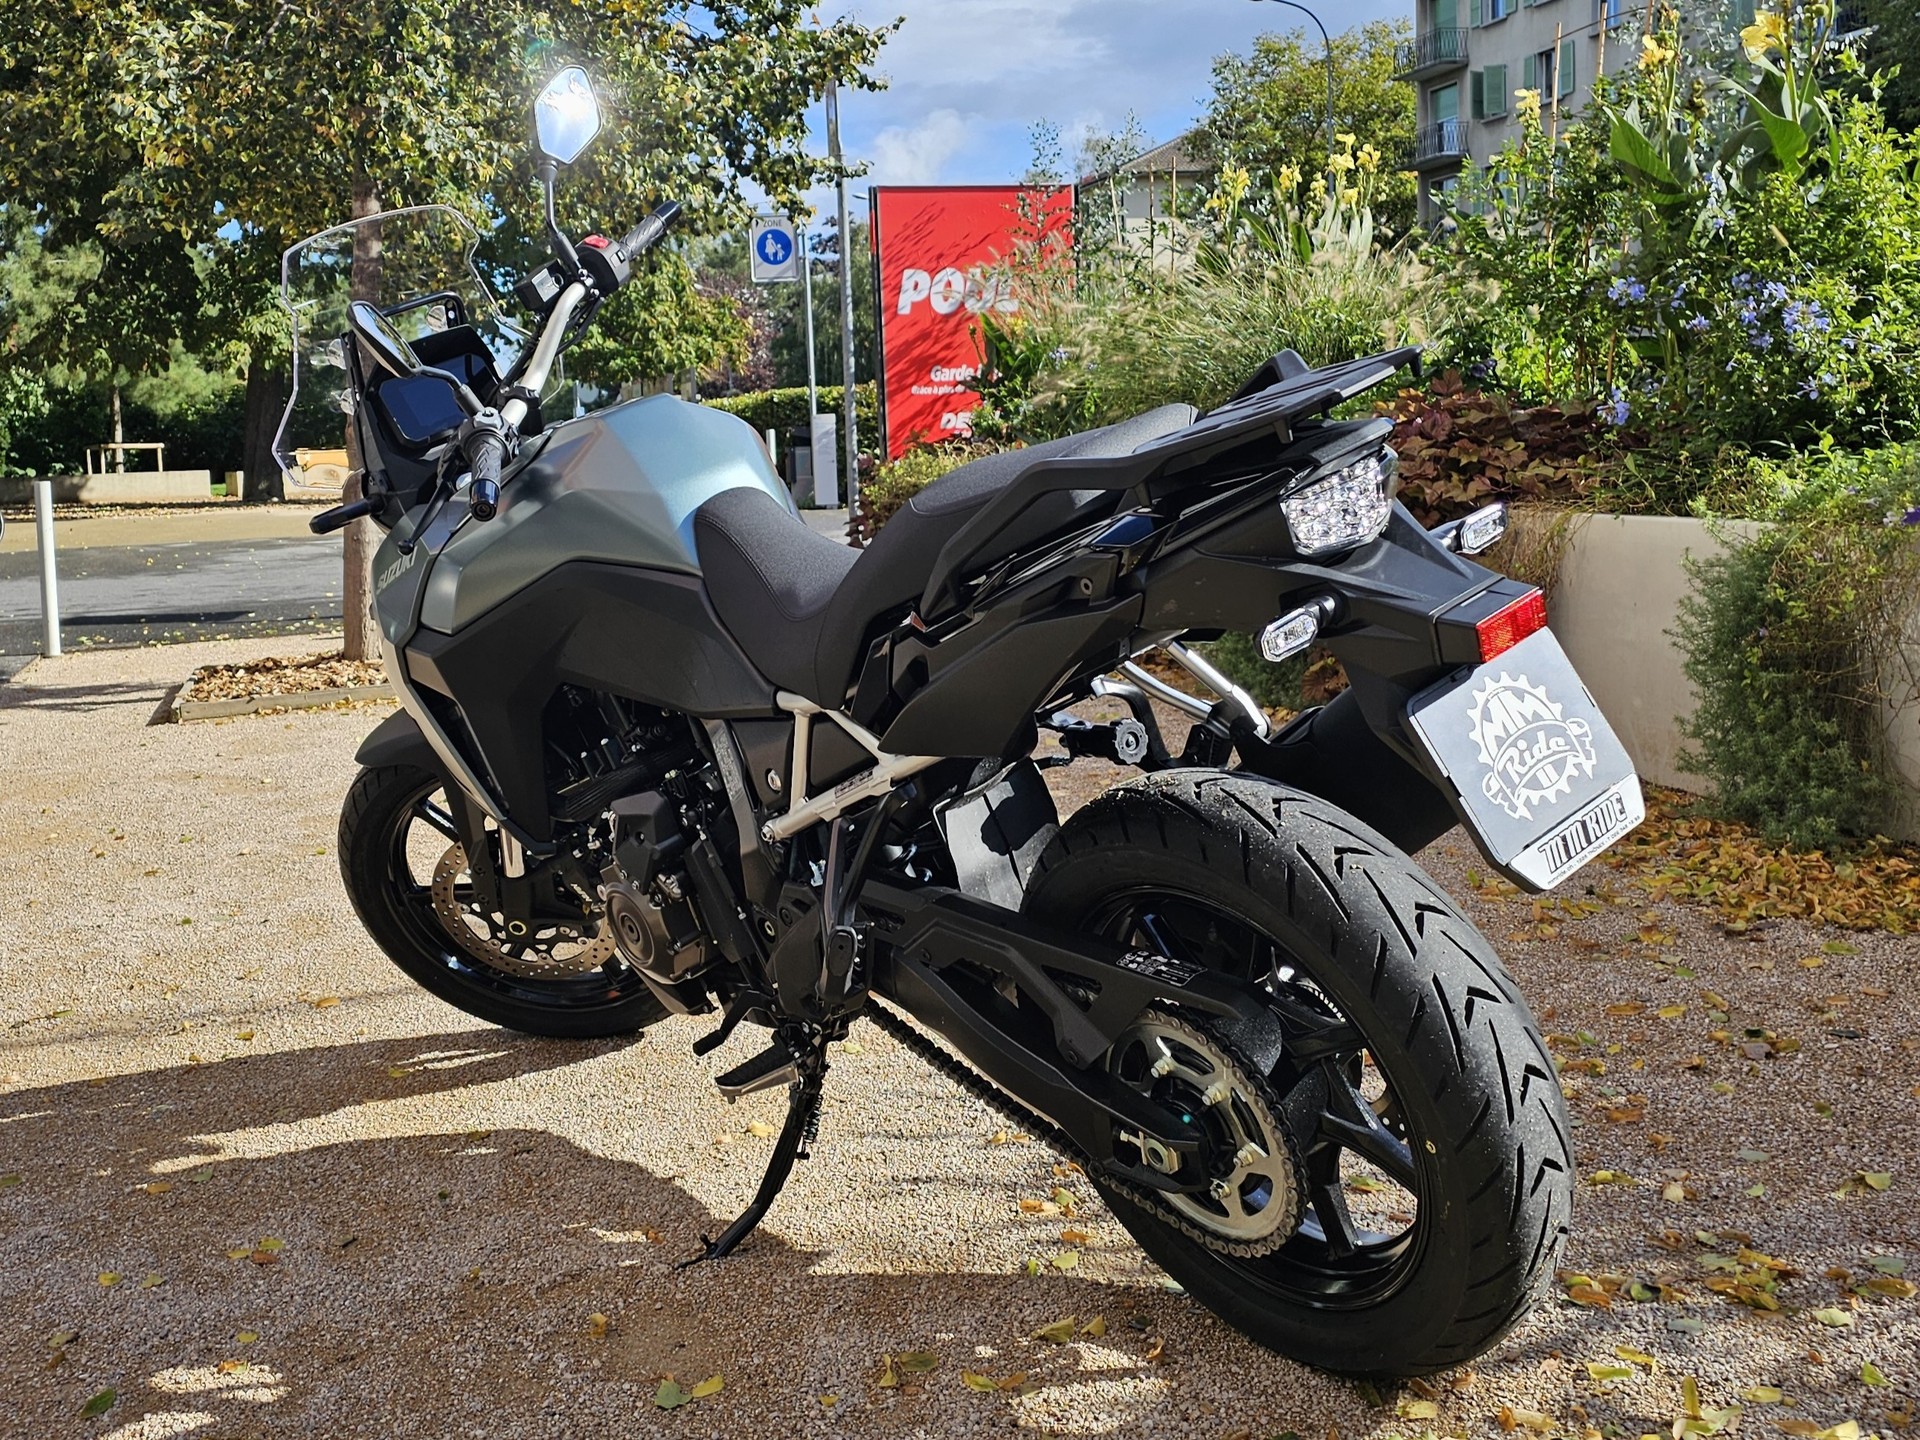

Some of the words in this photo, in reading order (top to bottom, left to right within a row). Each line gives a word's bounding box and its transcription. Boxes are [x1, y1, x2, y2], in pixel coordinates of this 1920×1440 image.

[763, 219, 783, 228] ZONE
[930, 364, 975, 382] Garde
[376, 546, 418, 595] SUZUKI
[1482, 690, 1557, 761] MM
[1497, 730, 1571, 786] Ride
[1537, 820, 1590, 874] MM
[1581, 791, 1628, 845] RIDE
